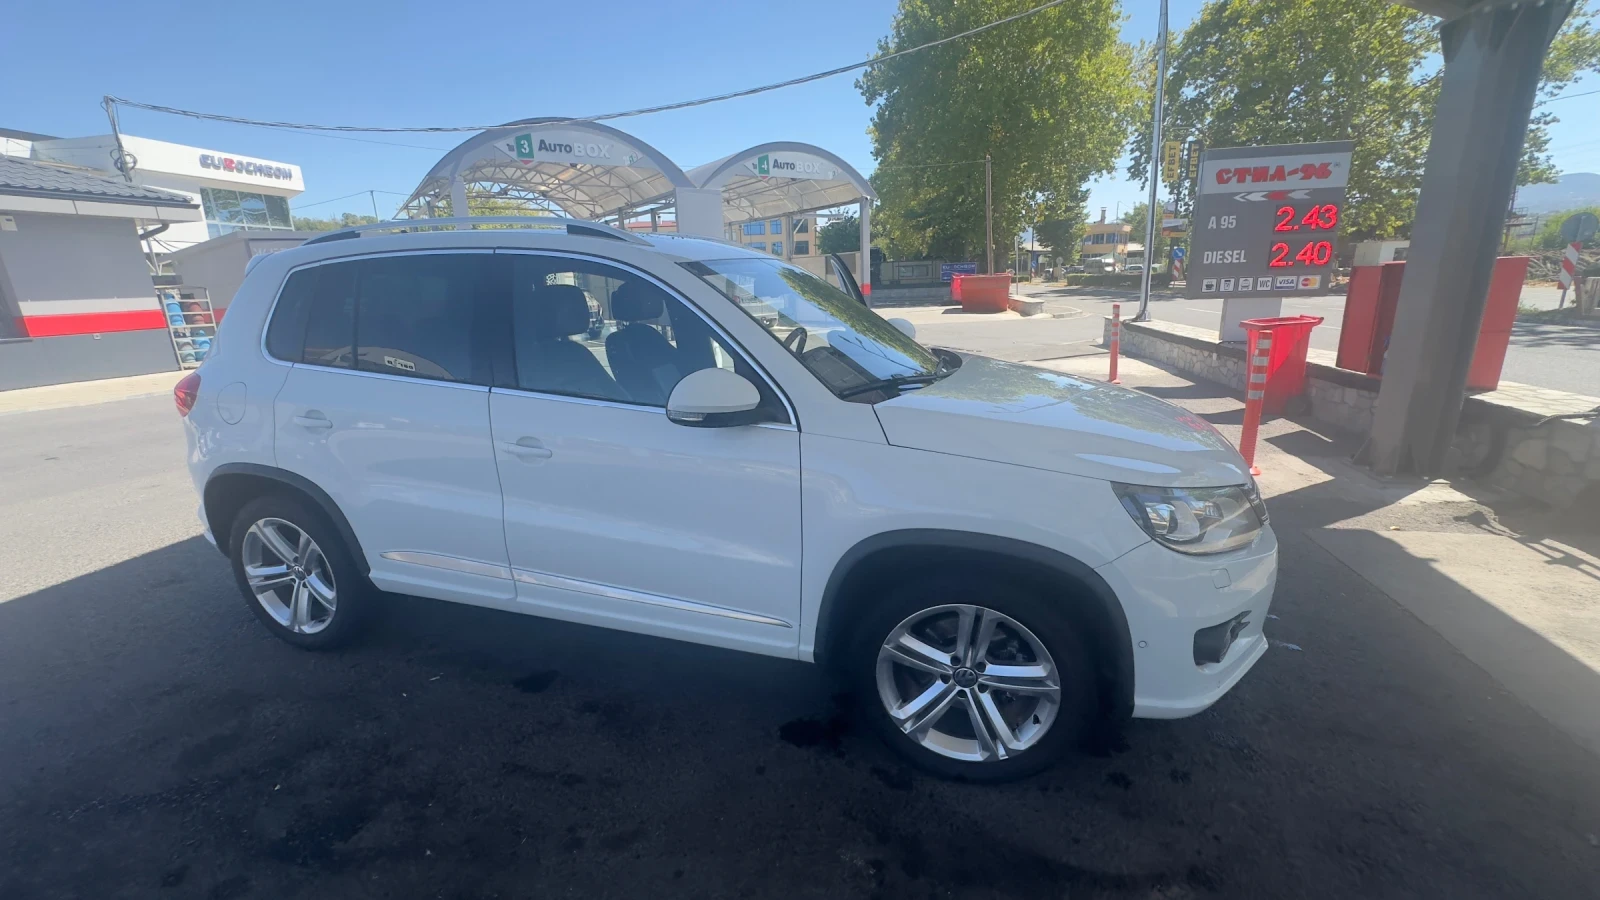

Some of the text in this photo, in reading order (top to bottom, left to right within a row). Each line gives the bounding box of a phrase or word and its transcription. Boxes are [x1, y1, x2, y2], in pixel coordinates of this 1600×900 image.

[520, 139, 530, 154] 3
[761, 161, 768, 171] 4
[1166, 145, 1178, 179] EFBET
[1188, 143, 1200, 178] EFBET
[1216, 162, 1333, 185] СТИЛ-96
[1208, 204, 1338, 232] A 95 2.43
[1203, 240, 1333, 268] DIESEL 2.40
[1259, 279, 1270, 288] WC
